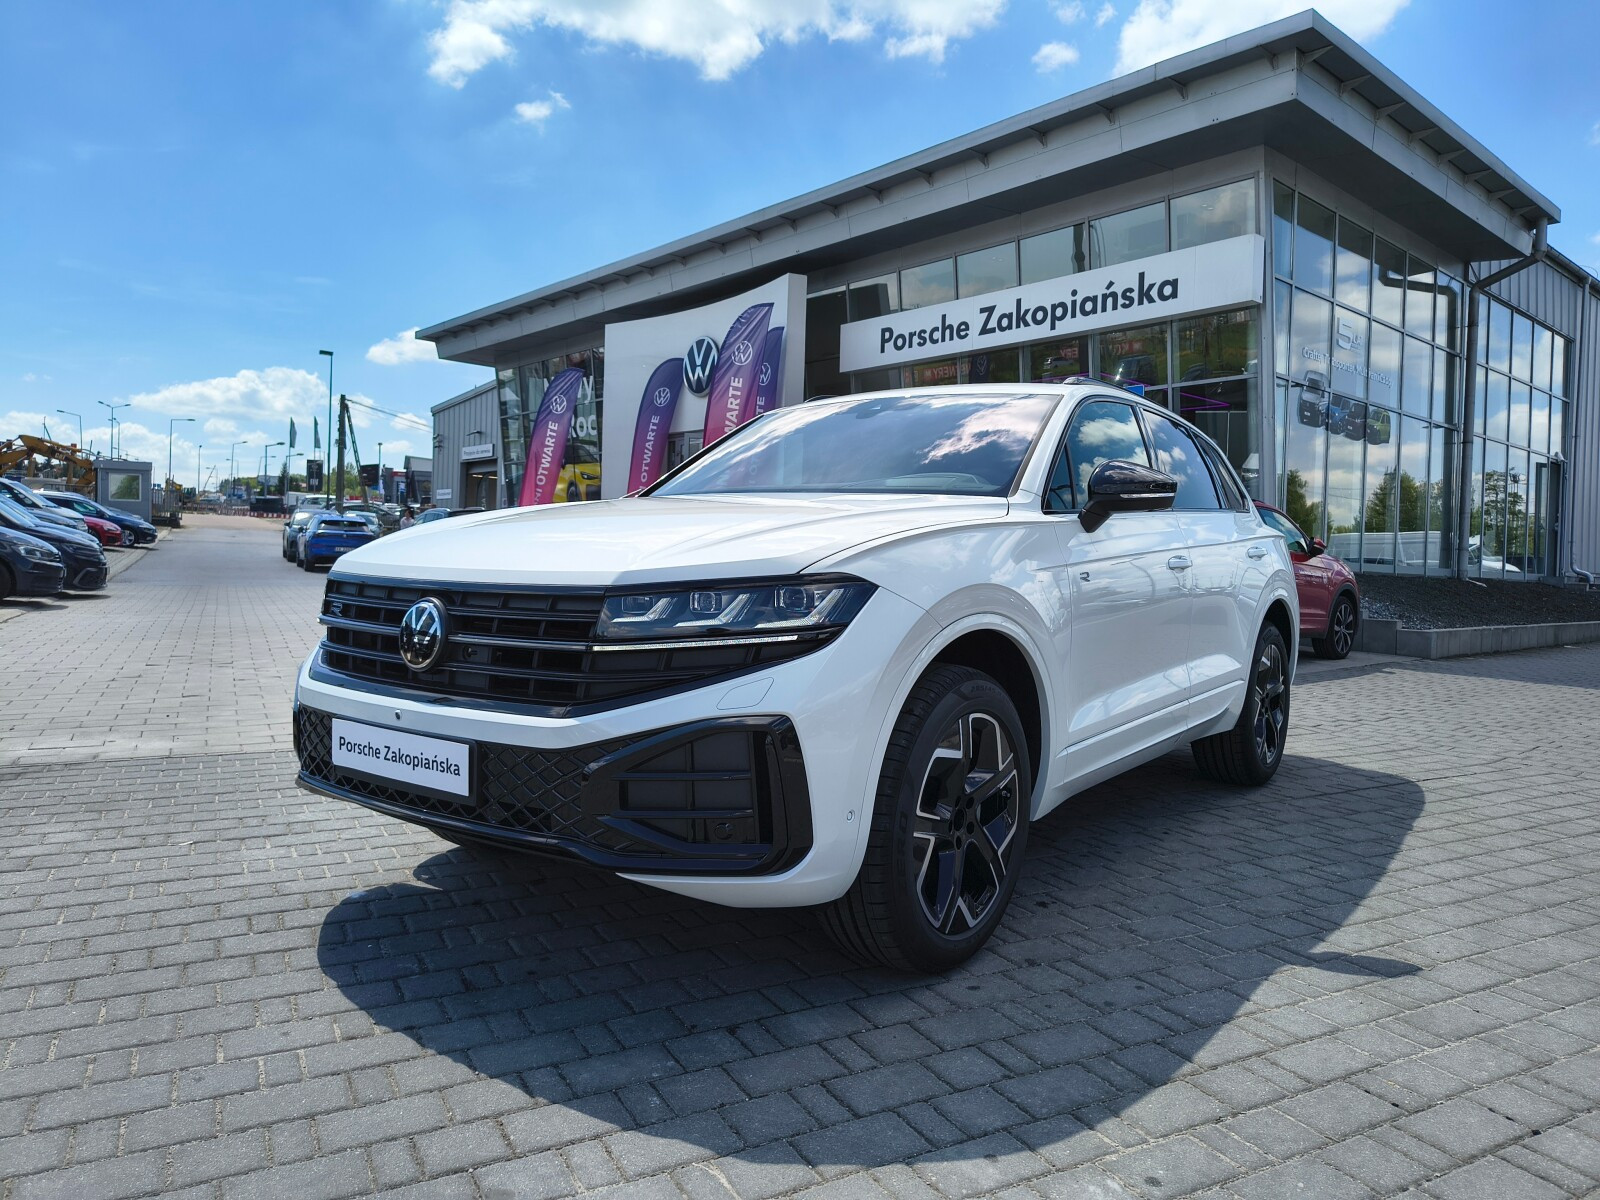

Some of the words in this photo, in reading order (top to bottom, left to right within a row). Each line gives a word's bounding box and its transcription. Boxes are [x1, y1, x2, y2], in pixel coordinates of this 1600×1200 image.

[880, 314, 970, 353] Porsche
[978, 271, 1179, 336] Zakopiańska
[536, 421, 558, 486] OTWARTE
[641, 415, 660, 482] OTWARTE
[338, 735, 381, 759] Porsche
[384, 745, 461, 776] Zakopiańska
